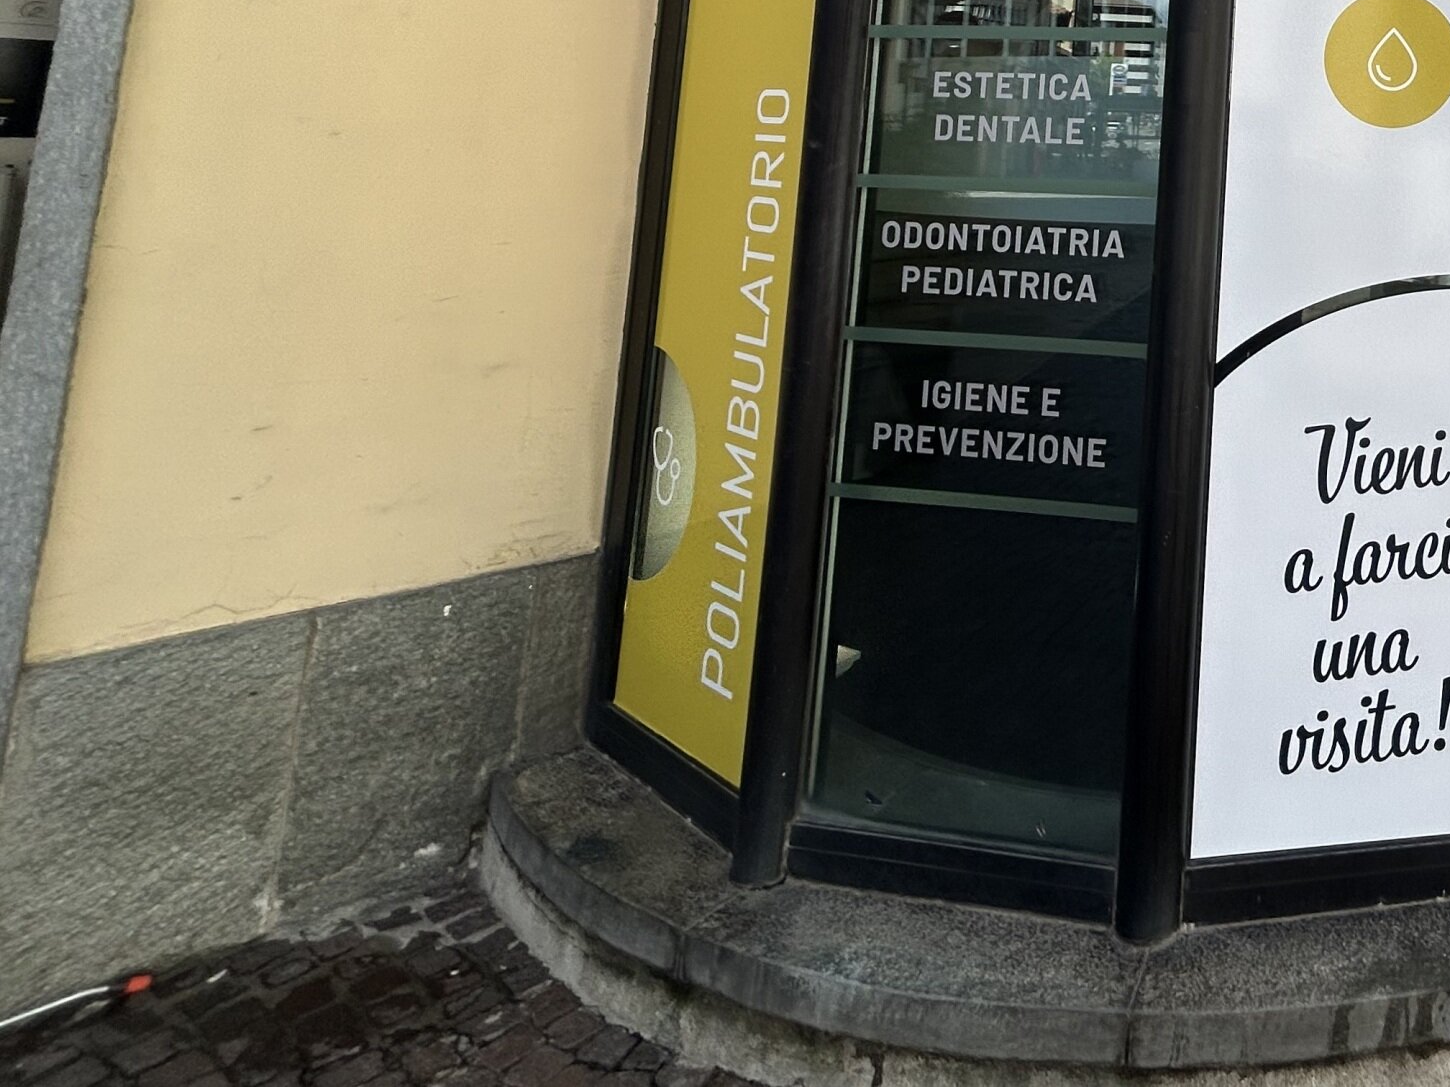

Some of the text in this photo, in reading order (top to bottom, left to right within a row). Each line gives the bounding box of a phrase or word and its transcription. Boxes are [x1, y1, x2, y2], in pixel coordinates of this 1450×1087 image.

[932, 71, 1092, 101] ESTETICA
[934, 114, 1086, 145] DENTALE
[880, 220, 1125, 258] ODONTOIATRIA
[901, 265, 1098, 303] PEDIATRICA
[700, 88, 791, 701] POLIAMBULATORIO
[921, 379, 1061, 417] IGIENE E
[872, 422, 1107, 468] PREVENZIONE
[1304, 416, 1450, 505] Vieni
[1284, 548, 1324, 594] a
[1312, 628, 1420, 683] una
